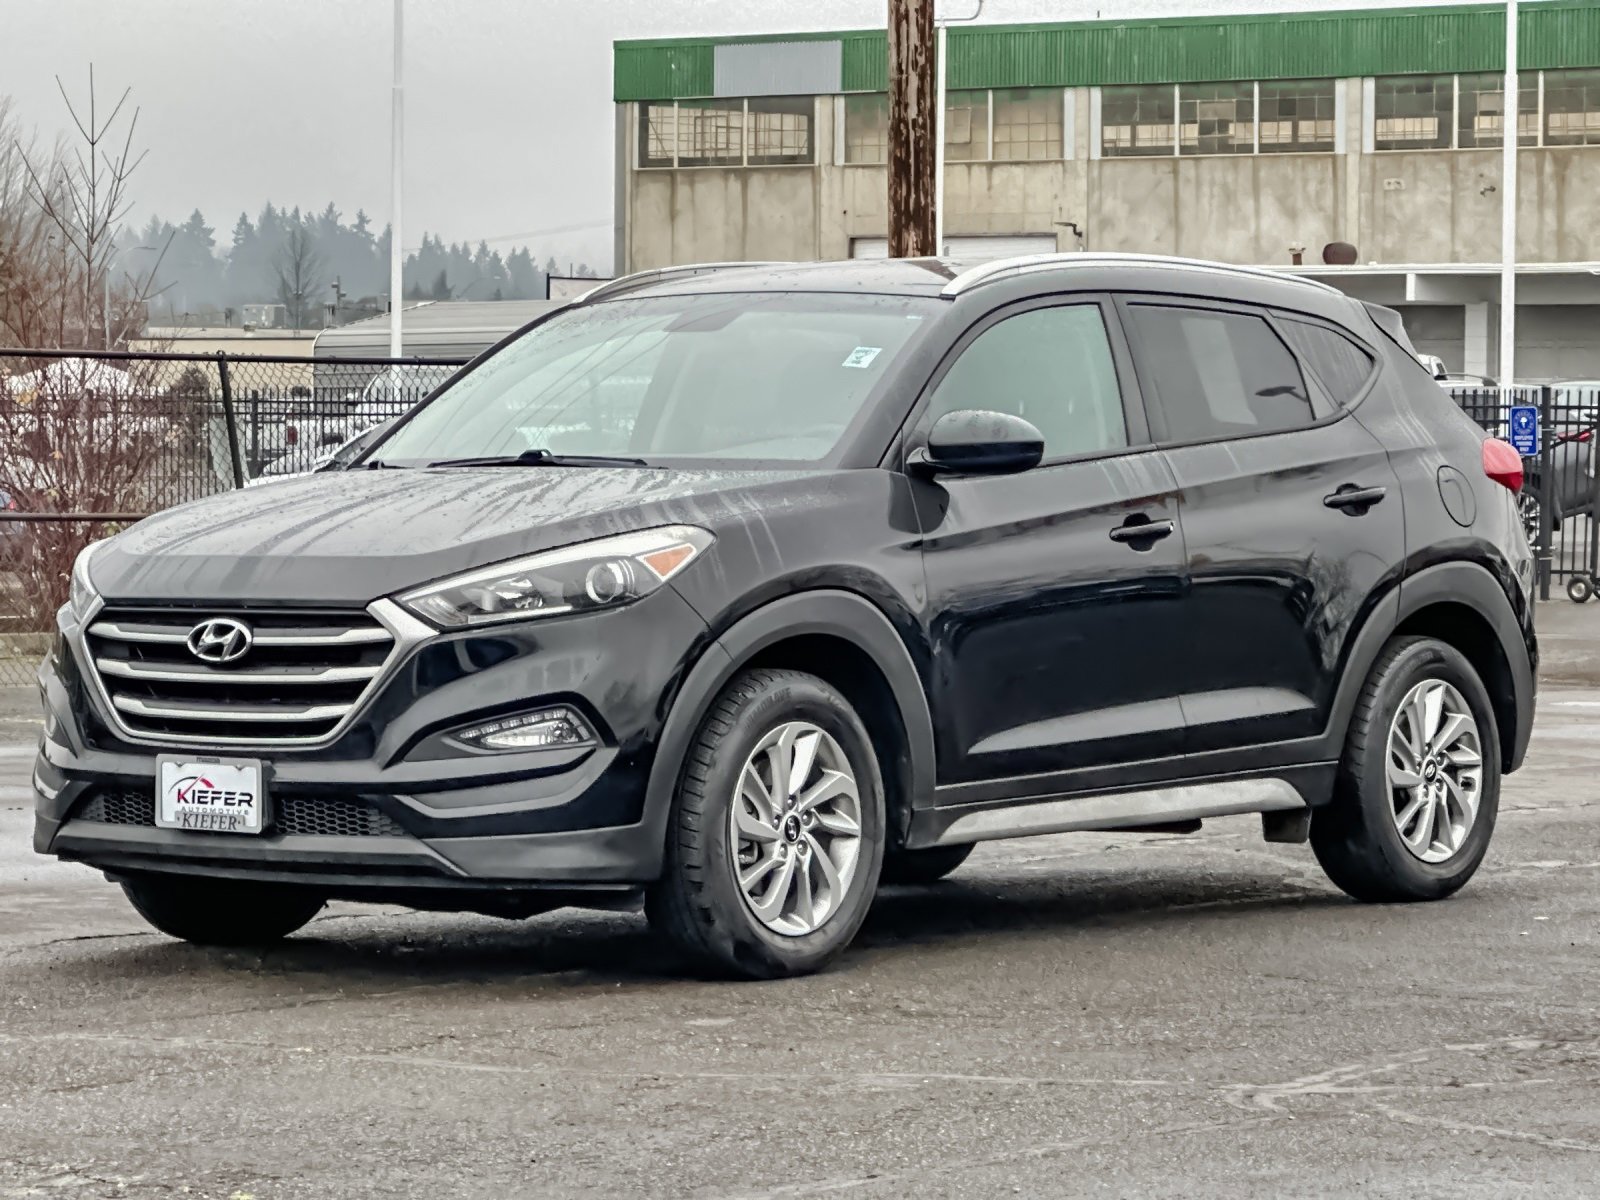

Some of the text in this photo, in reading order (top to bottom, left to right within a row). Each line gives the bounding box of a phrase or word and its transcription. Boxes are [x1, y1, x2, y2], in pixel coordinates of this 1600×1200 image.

[177, 787, 254, 807] KIEFER
[181, 806, 249, 815] AUTOMOTIVE
[182, 812, 237, 830] KIEFER
